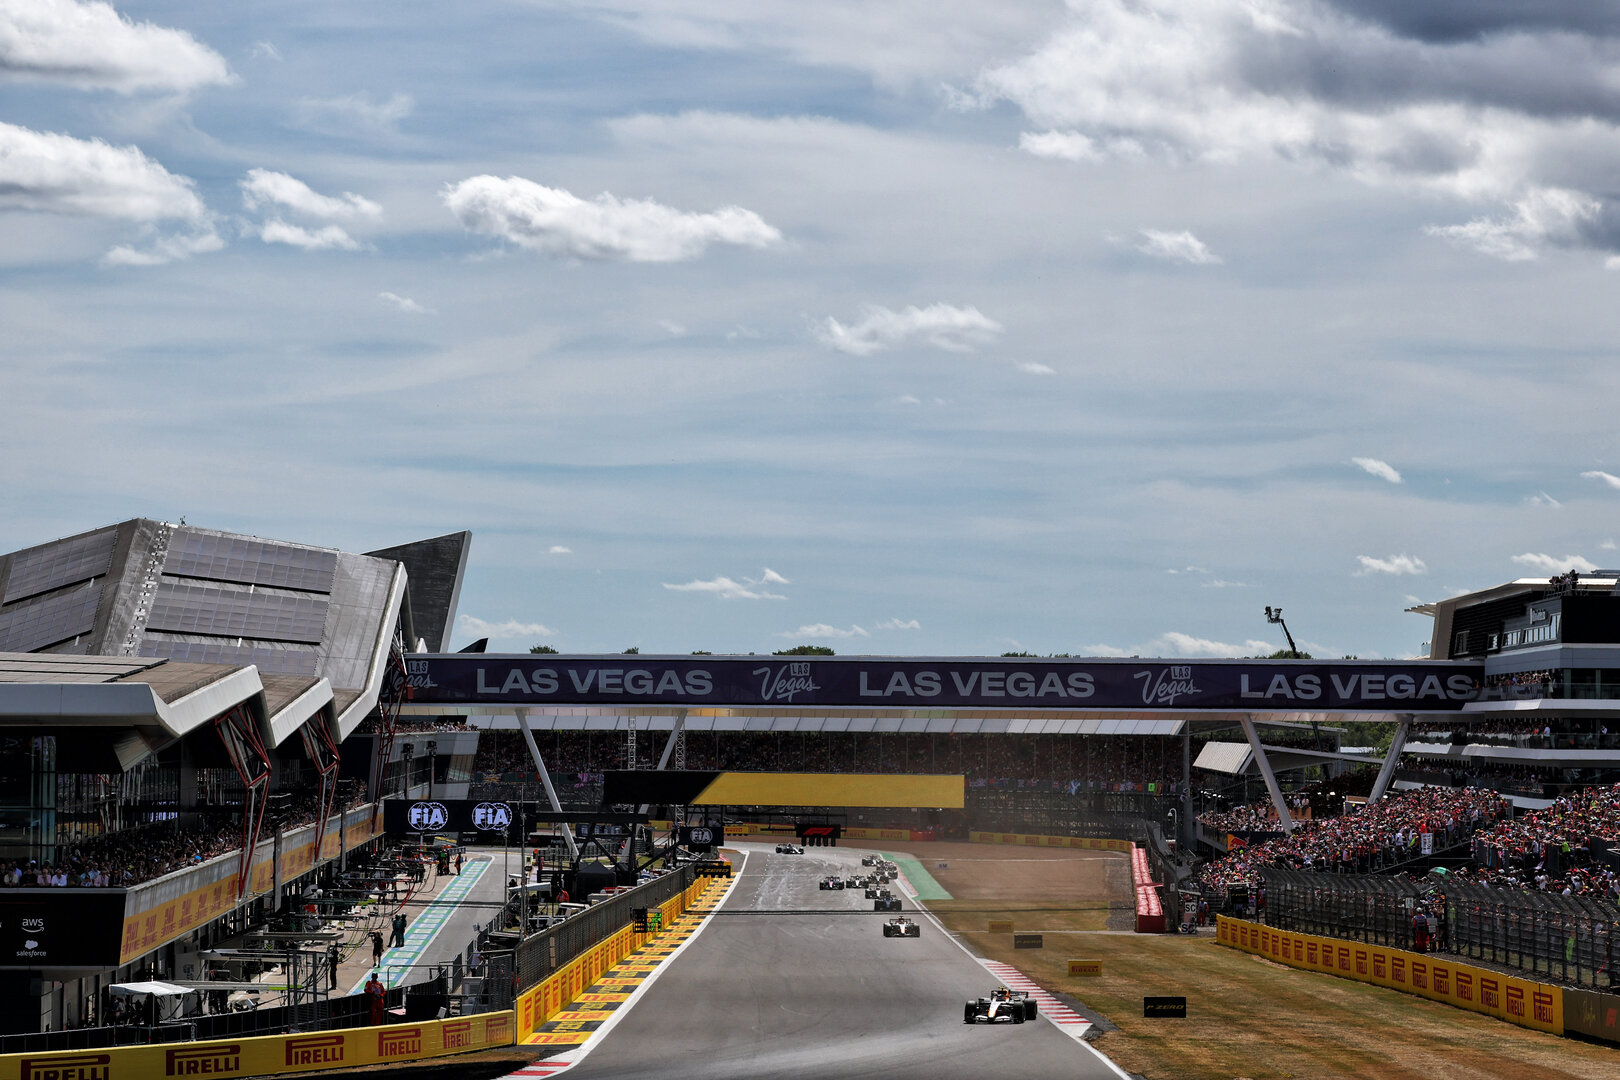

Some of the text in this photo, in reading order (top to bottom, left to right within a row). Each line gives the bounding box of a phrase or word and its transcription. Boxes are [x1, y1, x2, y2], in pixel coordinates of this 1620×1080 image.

[409, 662, 427, 673] LAS
[791, 664, 809, 675] LAS
[1171, 667, 1190, 679] LAS
[477, 669, 713, 695] LAS VEGAS
[753, 664, 821, 703] Vegas
[859, 671, 1095, 697] LAS VEGAS
[1134, 668, 1202, 705] Vegas
[1241, 673, 1475, 700] LAS VEGAS
[1185, 904, 1196, 912] SC
[22, 918, 44, 927] aws
[1533, 991, 1554, 1025] PIRELLI
[378, 1028, 422, 1057] PIRELLI
[443, 1021, 471, 1049] PIRELLI
[486, 1016, 508, 1043] PIRELLI
[165, 1044, 241, 1076] PIRELLI
[286, 1035, 345, 1066] PIRELLI
[20, 1054, 111, 1080] PIRELLI
